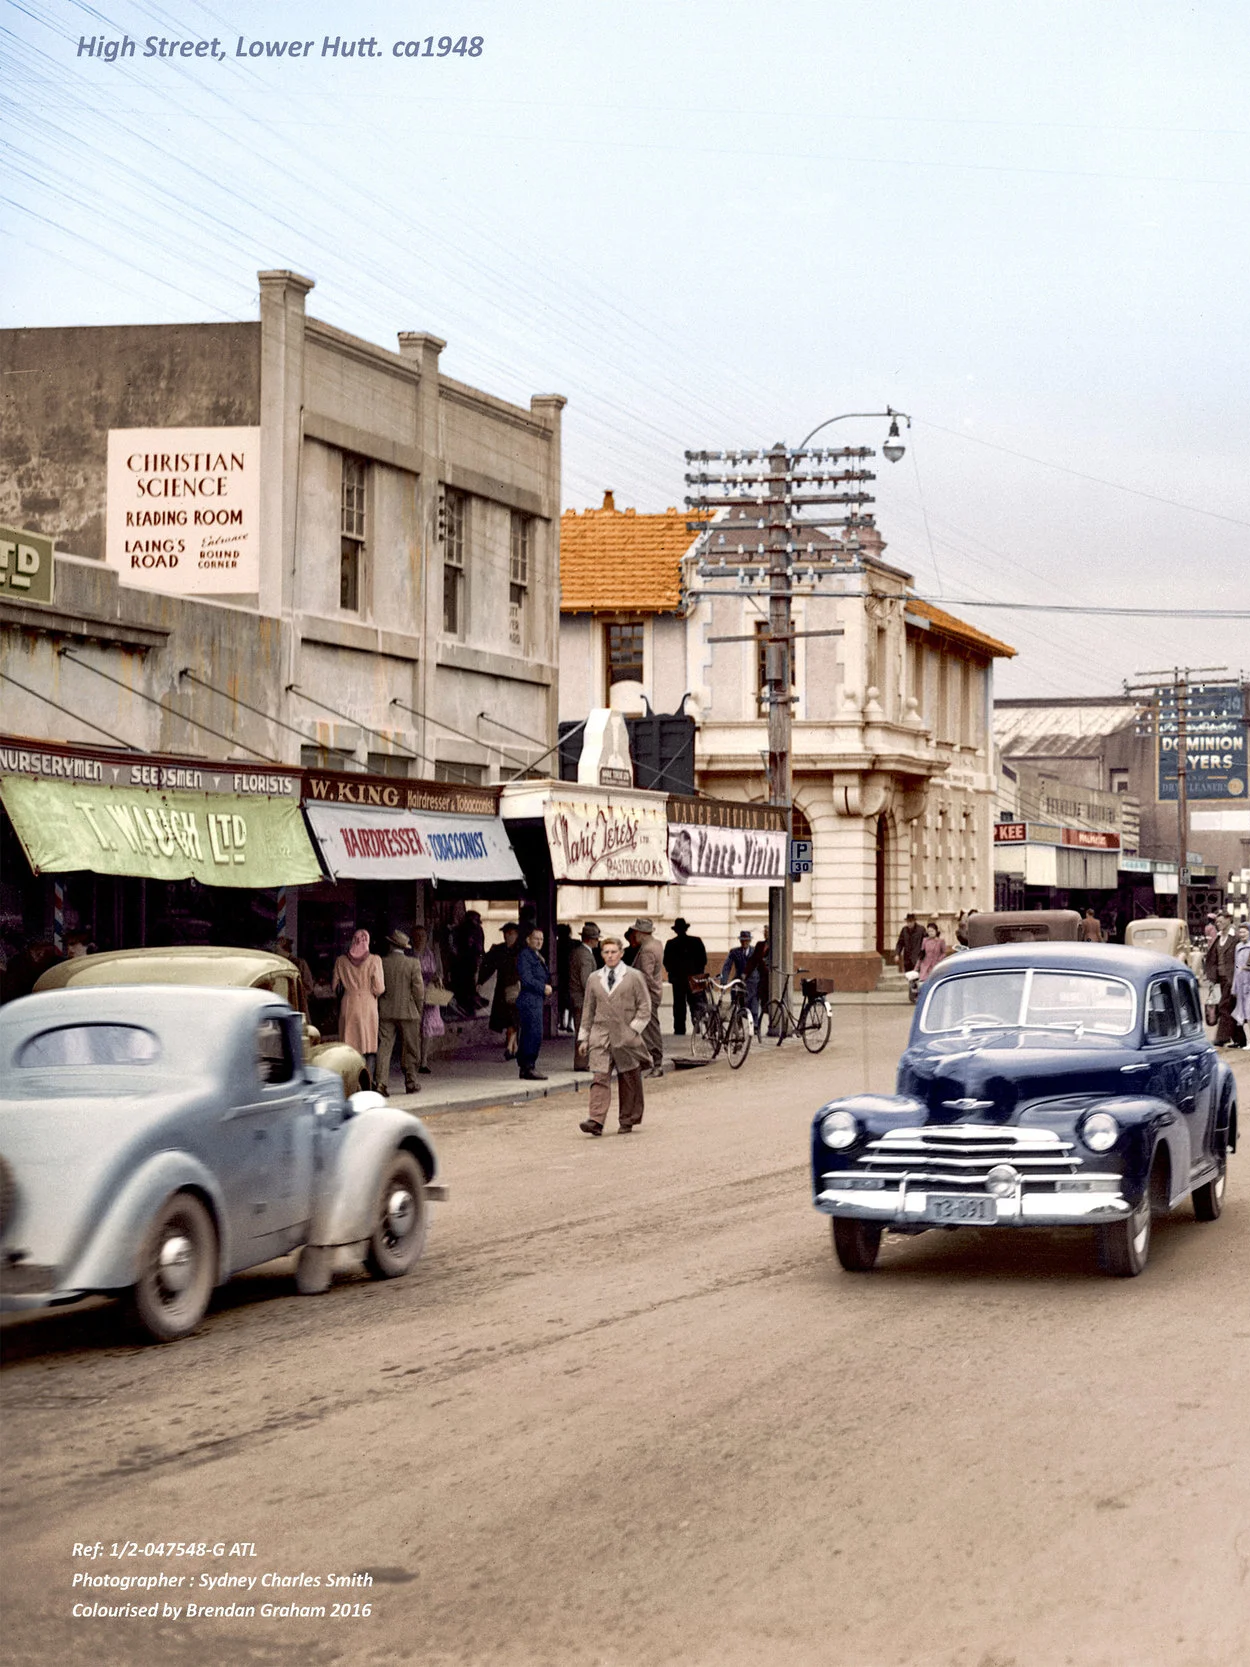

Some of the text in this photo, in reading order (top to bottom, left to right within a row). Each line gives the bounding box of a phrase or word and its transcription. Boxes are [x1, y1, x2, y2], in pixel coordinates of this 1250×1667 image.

[126, 452, 245, 473] CHRISTIAN
[136, 476, 228, 498] SCIENCE
[126, 509, 243, 527] READING ROOM
[125, 538, 186, 553] LAING'S
[201, 532, 249, 549] Entrance
[0, 540, 40, 574] TD
[130, 554, 179, 569] ROAD
[199, 550, 241, 560] ROUND
[198, 560, 238, 570] CORNER
[1185, 755, 1233, 770] YERS
[0, 748, 293, 795] NURSERYMEN SEEDSMEN FLORISTS
[407, 789, 450, 811] Hairdresser
[104, 804, 204, 862] WAUGH
[207, 813, 248, 864] LTD
[340, 827, 488, 861] HAIRDRESSER TOBACCONIST
[797, 842, 807, 858] P
[794, 862, 809, 872] 30
